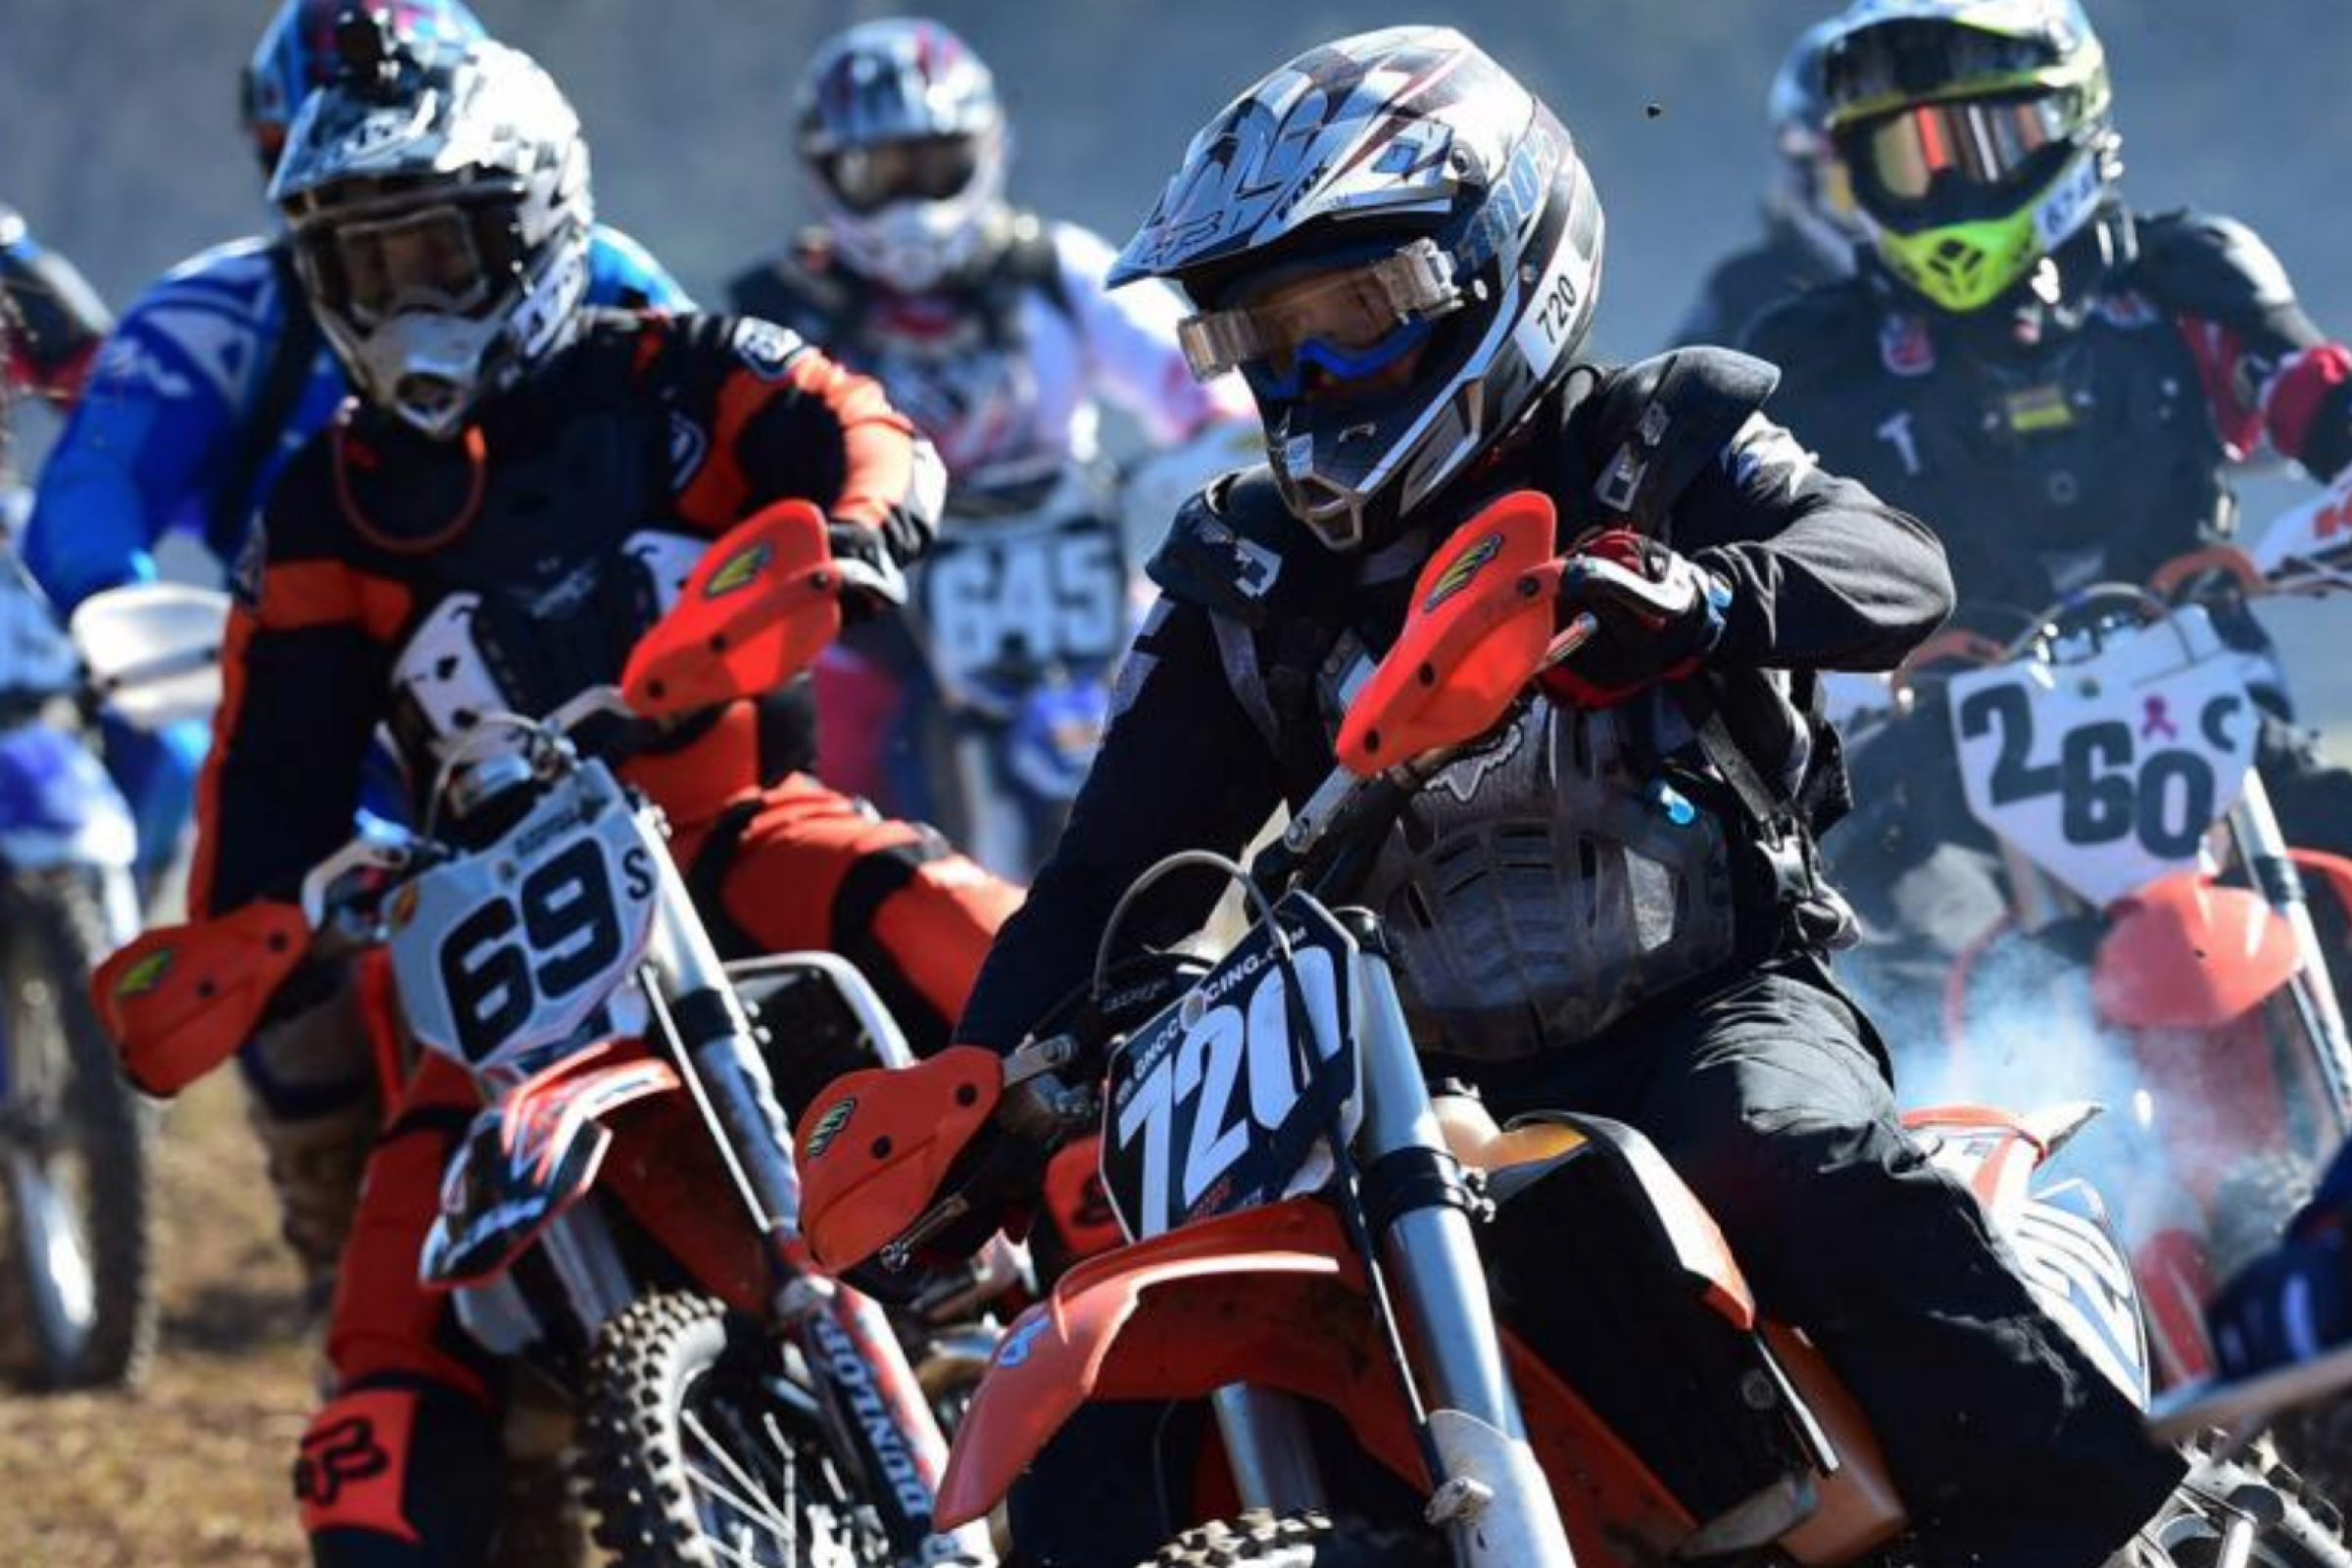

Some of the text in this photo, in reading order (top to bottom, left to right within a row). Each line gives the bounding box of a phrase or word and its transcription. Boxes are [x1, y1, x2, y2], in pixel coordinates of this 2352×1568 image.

[1537, 273, 1578, 345] 720
[933, 537, 1117, 668] 645
[1960, 682, 2216, 860] 260
[439, 836, 652, 1063] 69 S
[1117, 945, 1343, 1239] 720
[815, 1316, 936, 1516] DUNLOP
